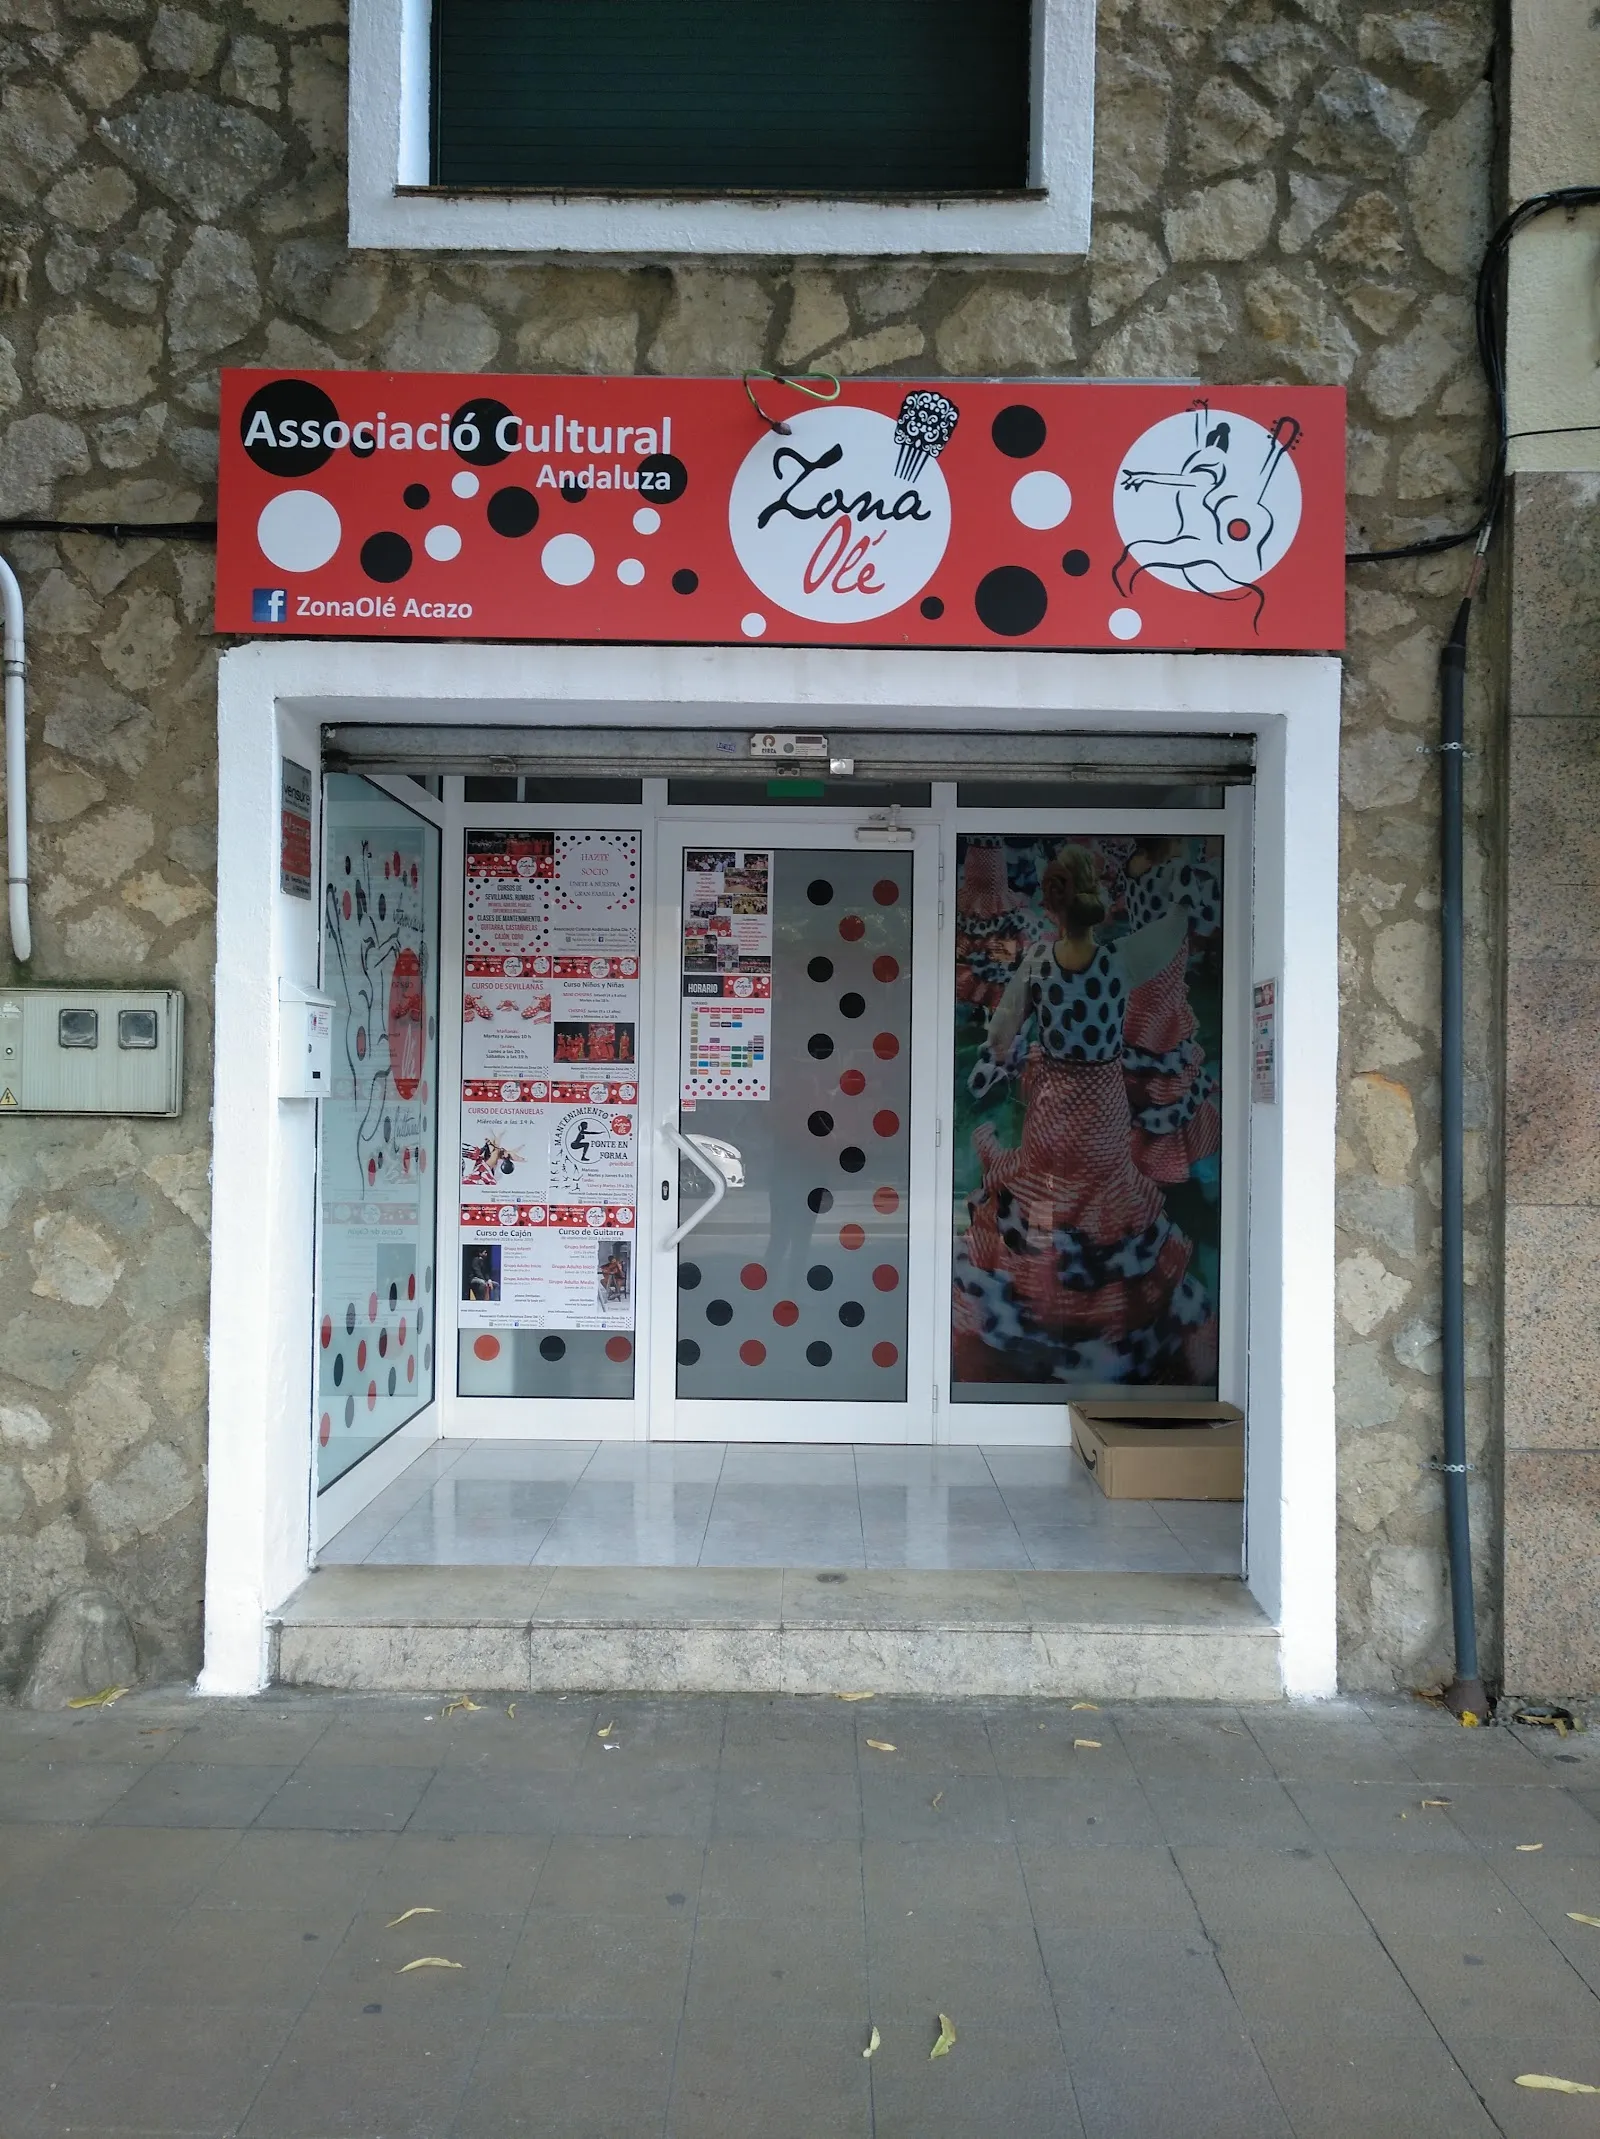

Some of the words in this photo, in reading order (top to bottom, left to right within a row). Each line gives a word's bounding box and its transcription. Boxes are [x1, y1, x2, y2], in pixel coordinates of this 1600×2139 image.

[243, 410, 482, 452] Associació
[495, 414, 672, 455] Cultural
[536, 464, 671, 491] Andaluza
[757, 443, 931, 529] Zona
[803, 515, 887, 596] Olé
[296, 595, 396, 619] ZonaOlé
[402, 597, 473, 620] Acazo
[472, 982, 493, 990] CURSO
[495, 982, 504, 990] DE
[505, 982, 544, 990] SEVILLANAS
[688, 983, 718, 994] HORARIO
[554, 1107, 609, 1147] MANTENIMIENTO
[600, 1152, 628, 1160] FORMA
[510, 1230, 532, 1238] Cajón
